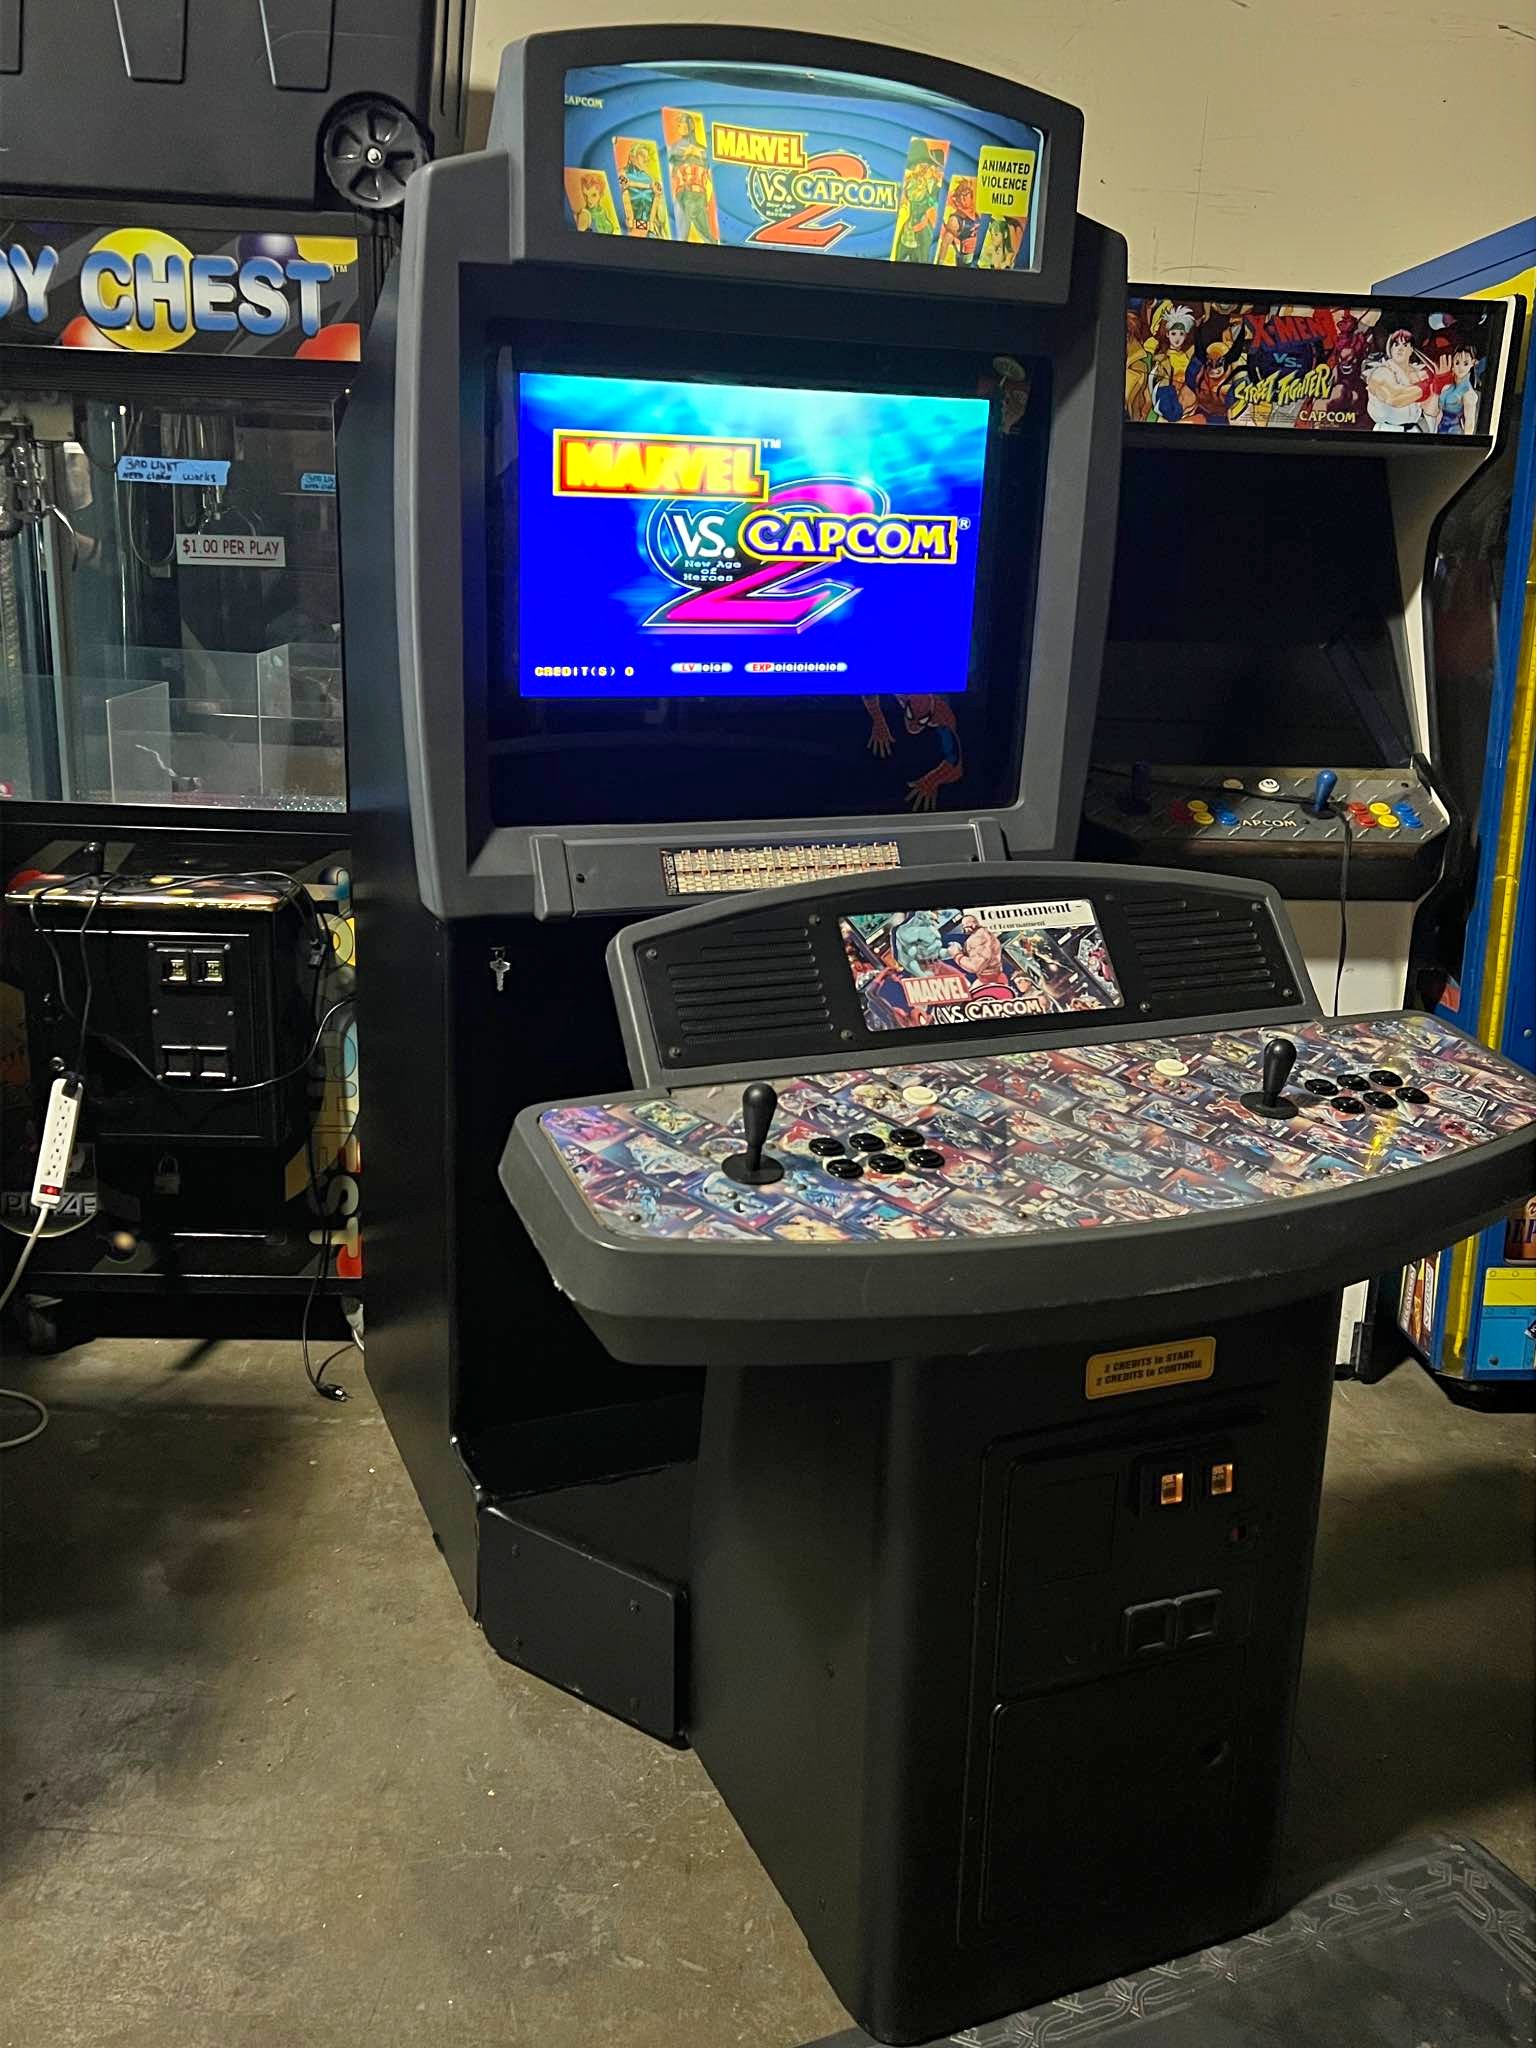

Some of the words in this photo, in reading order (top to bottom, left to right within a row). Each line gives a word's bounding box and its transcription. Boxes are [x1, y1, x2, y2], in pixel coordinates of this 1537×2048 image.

[716, 127, 804, 165] MARVEL
[982, 160, 1030, 175] ANIMATED
[760, 173, 792, 202] VS.
[795, 178, 894, 207] CAPCOM
[982, 176, 1027, 190] VIOLENCE
[992, 193, 1014, 205] MILD
[80, 250, 335, 337] CHEST
[1277, 364, 1331, 407] FIGHTER
[1300, 410, 1356, 424] CAPCOM
[563, 440, 760, 494] MARVEL
[673, 514, 736, 558] VS.
[748, 519, 946, 555] CAPCOM
[183, 539, 218, 554] $1.00
[223, 539, 245, 555] PER
[250, 540, 280, 556] PLAY
[684, 559, 711, 569] New
[715, 559, 742, 570] Age
[683, 573, 734, 582] Heroes
[752, 663, 772, 672] EXP
[1242, 819, 1297, 828] APCOM
[904, 976, 969, 1004] MARVEL
[968, 998, 1042, 1019] CAPCOM
[1113, 1356, 1152, 1372] CREDITS
[1165, 1349, 1195, 1363] START
[1105, 1369, 1144, 1385] CREDITS
[1158, 1359, 1203, 1375] CONTINUE
